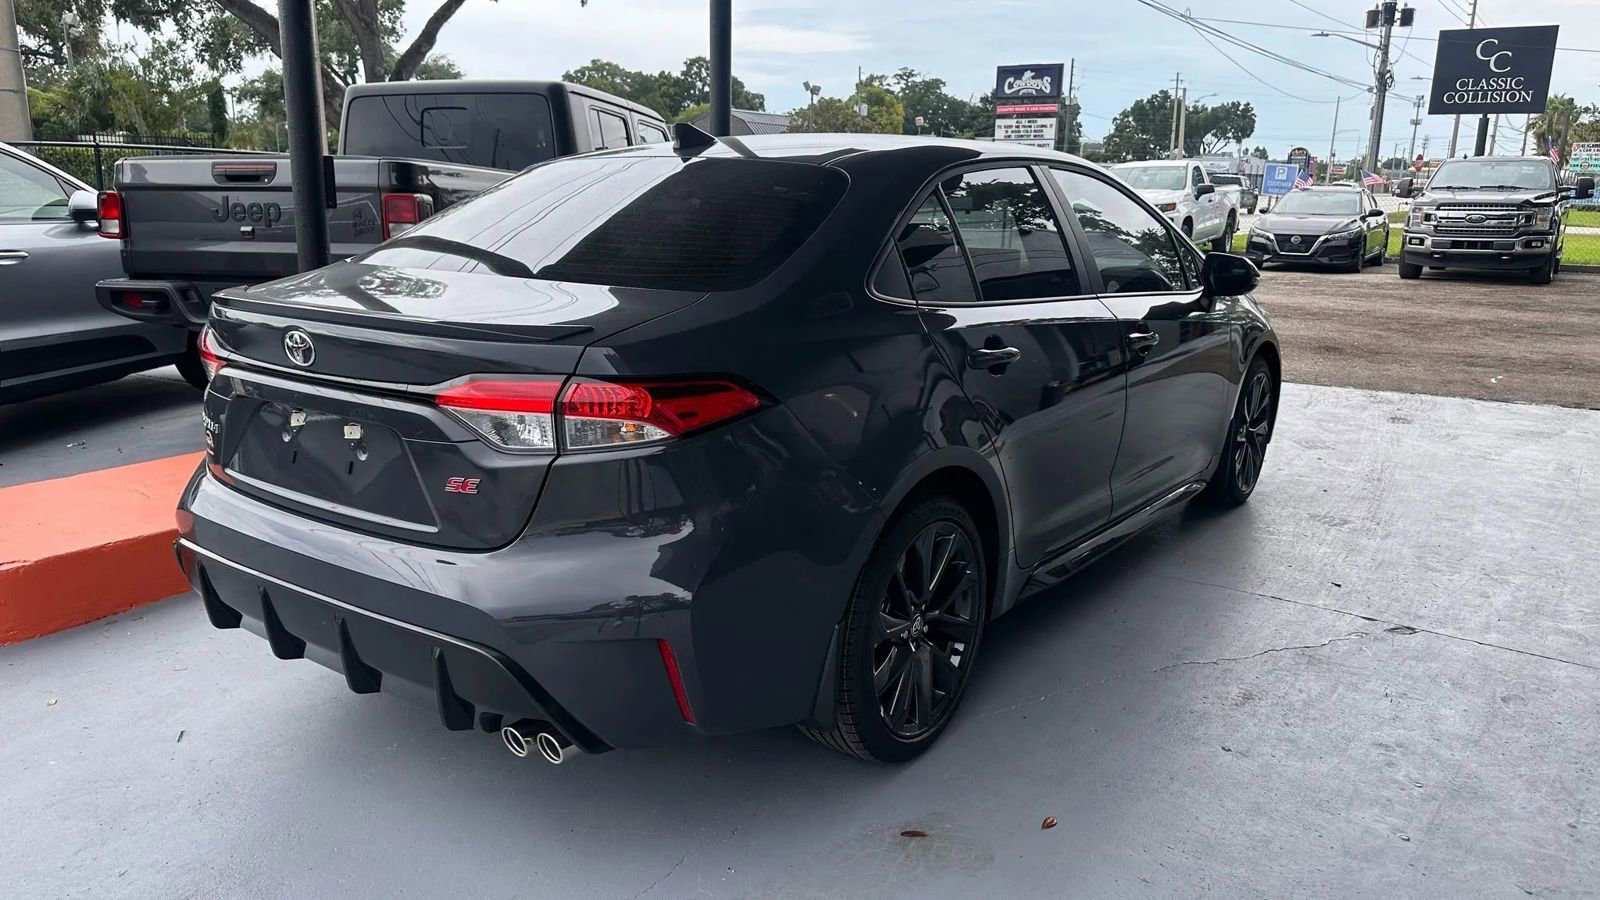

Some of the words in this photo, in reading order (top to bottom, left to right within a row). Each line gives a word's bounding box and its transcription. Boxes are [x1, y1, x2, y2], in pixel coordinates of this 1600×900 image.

[1456, 77, 1524, 91] CLASSIC
[1443, 90, 1534, 104] COLLISION
[210, 195, 282, 227] Jeep
[444, 476, 481, 494] SE
